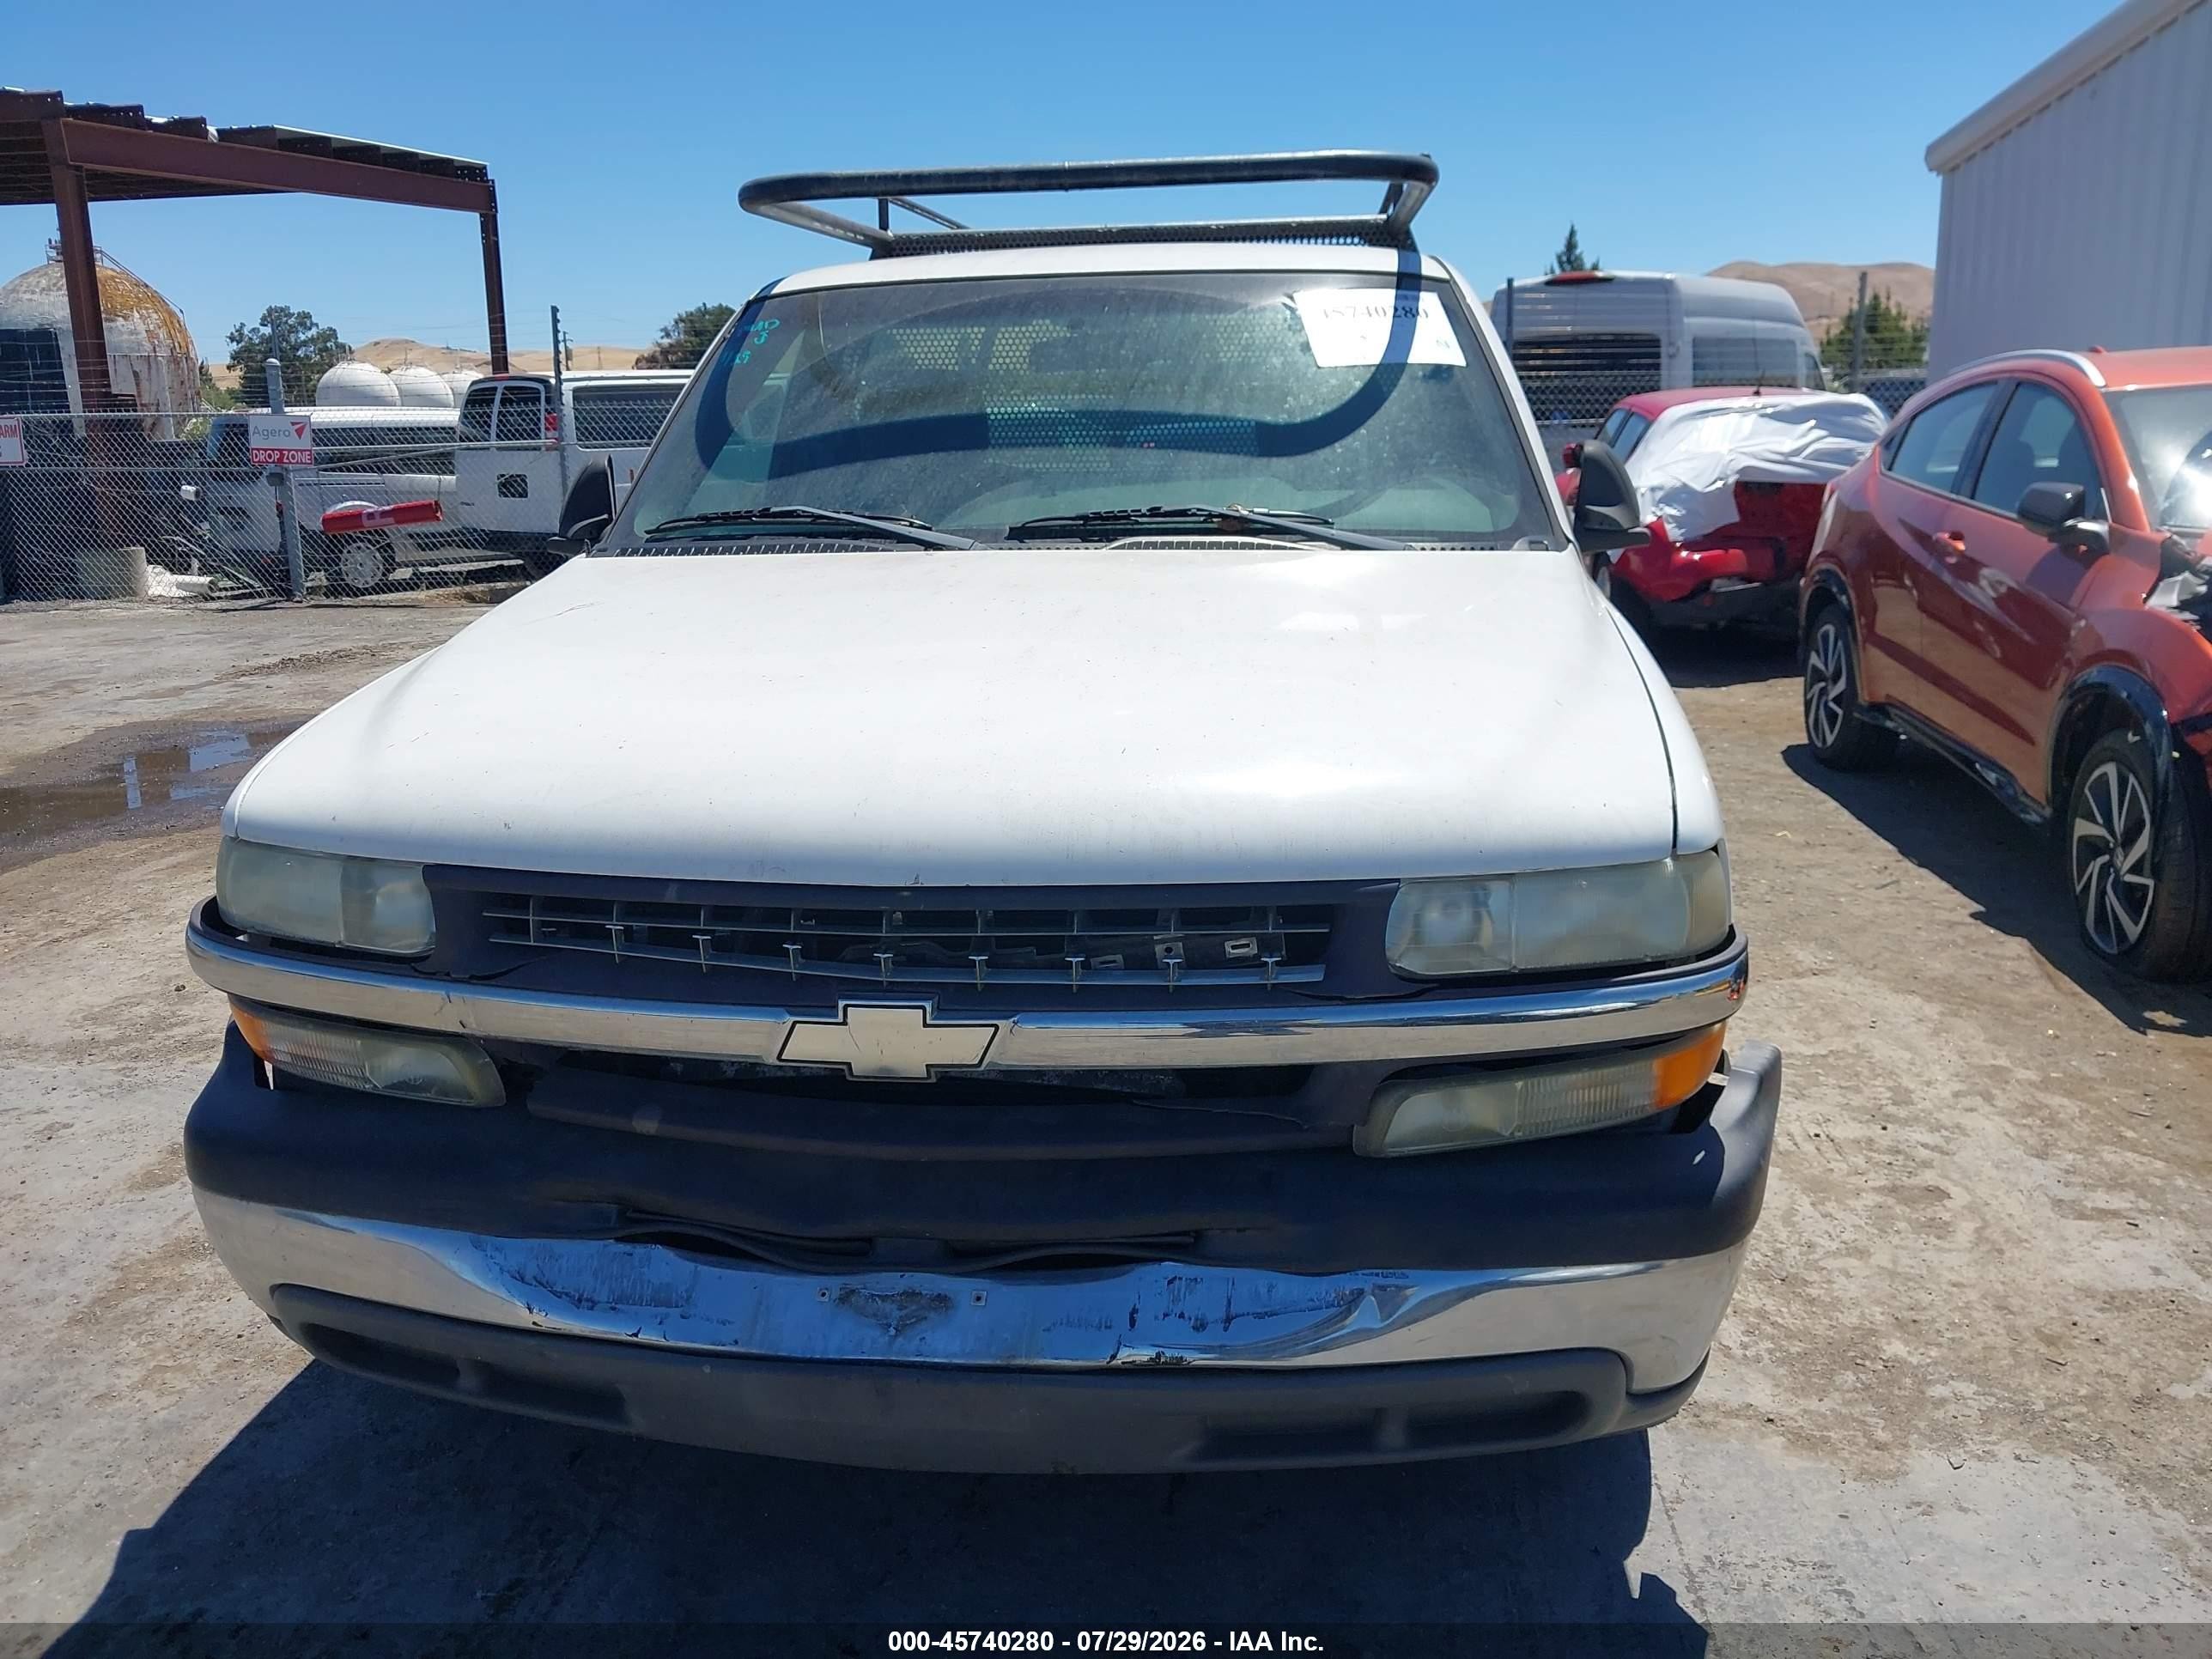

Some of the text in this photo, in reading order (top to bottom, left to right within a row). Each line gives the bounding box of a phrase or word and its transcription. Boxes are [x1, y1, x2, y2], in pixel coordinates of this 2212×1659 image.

[252, 426, 291, 440] Agero
[252, 450, 312, 463] DROP ZONE
